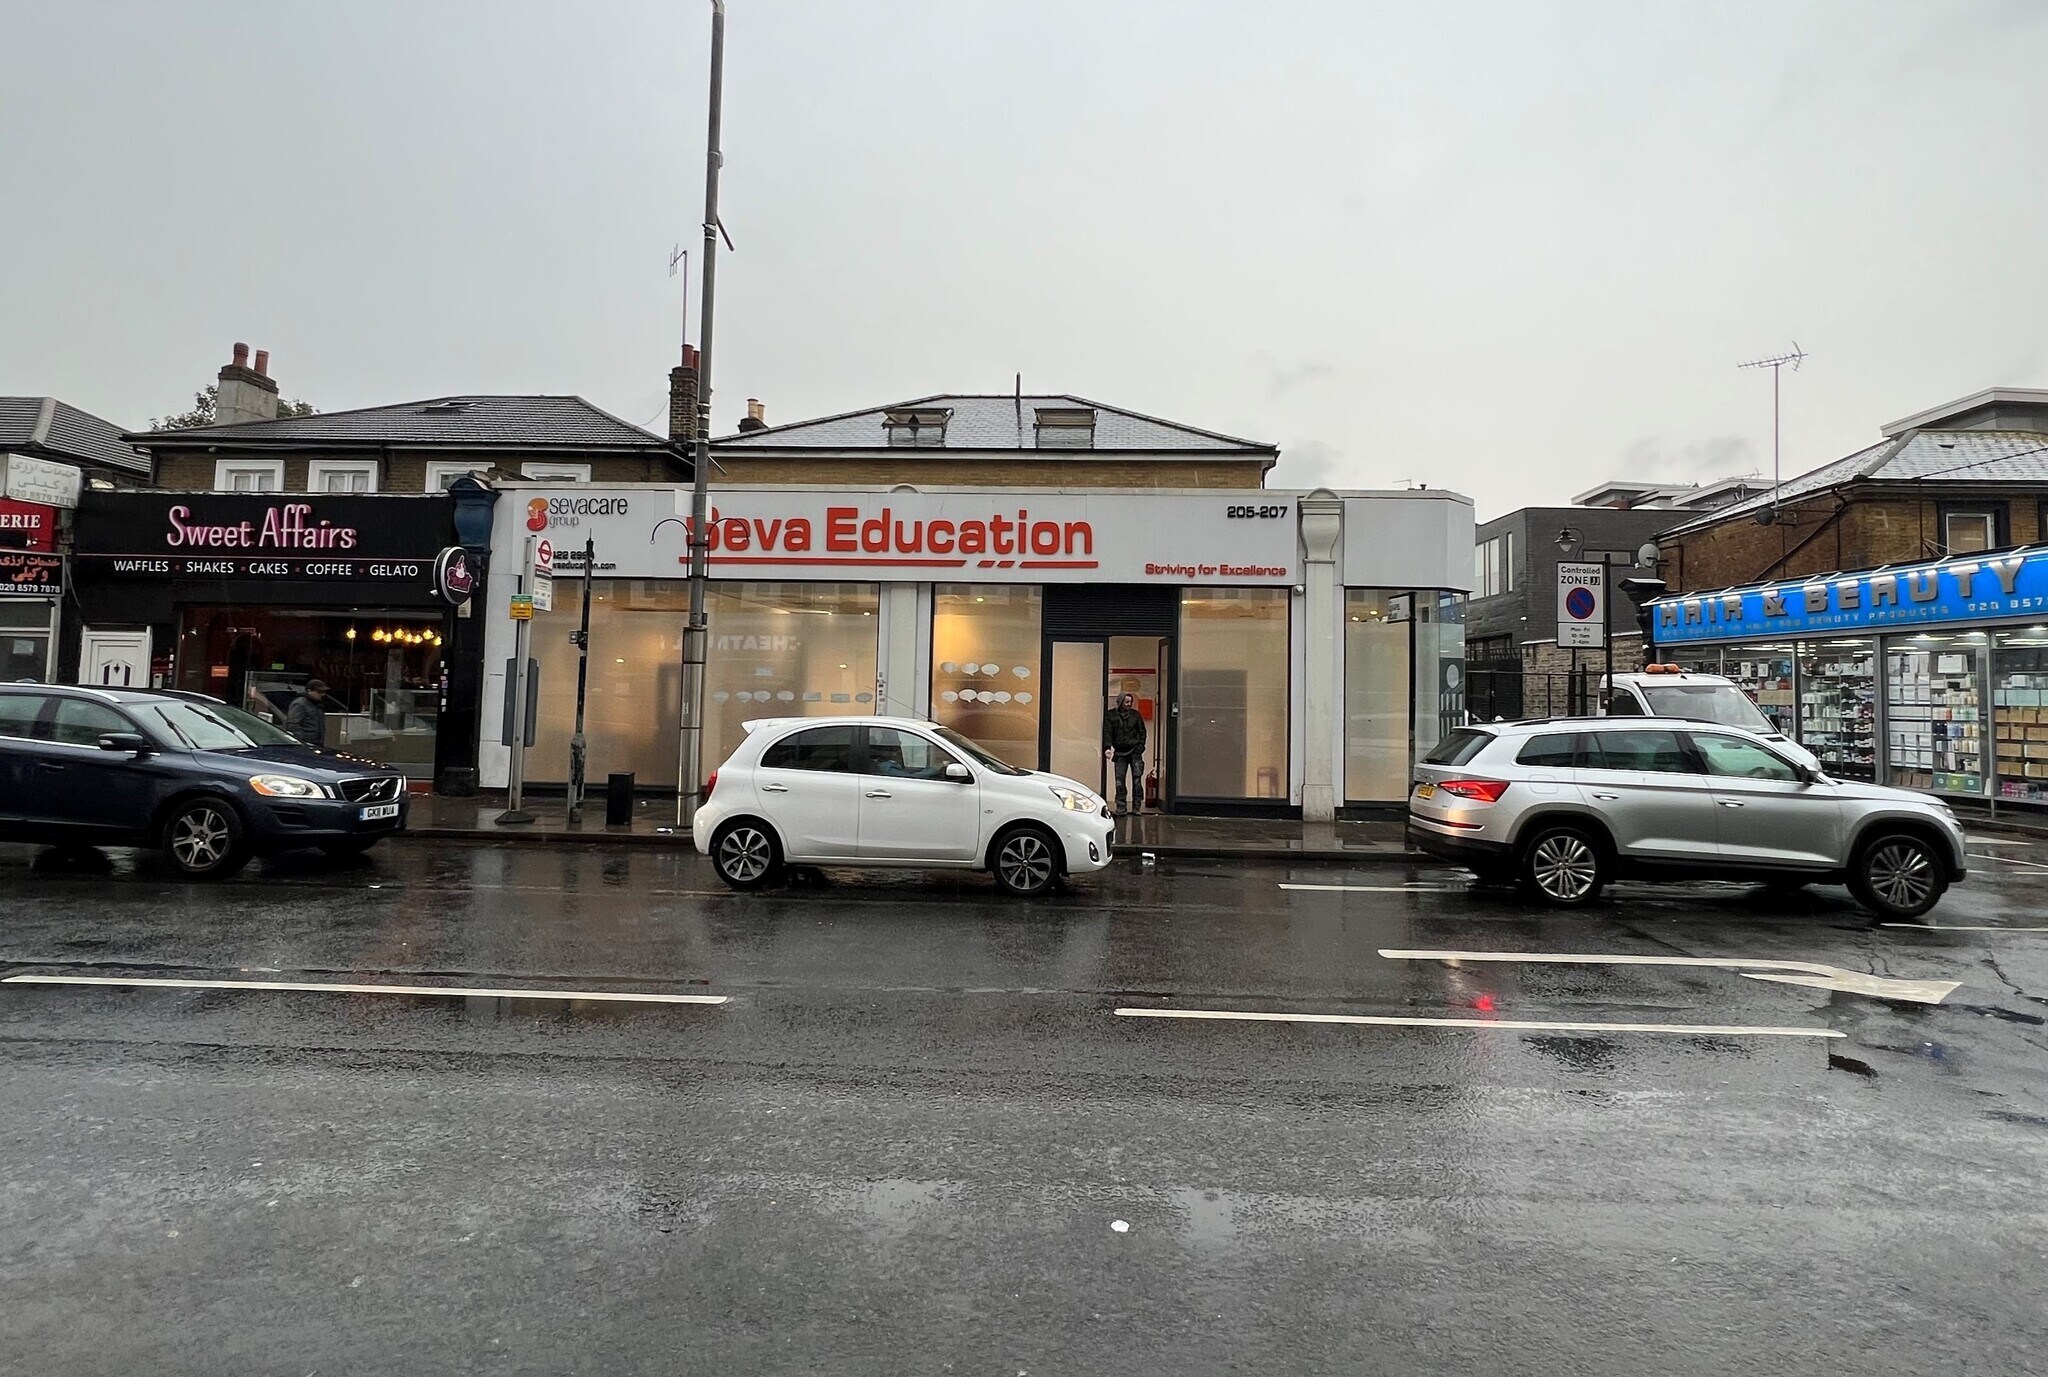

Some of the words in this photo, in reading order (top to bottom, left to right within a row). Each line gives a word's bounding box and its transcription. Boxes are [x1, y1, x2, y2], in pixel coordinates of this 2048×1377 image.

[9, 487, 27, 497] 020
[549, 497, 628, 516] sevacare
[1226, 506, 1288, 519] 205-207
[166, 505, 254, 547] Sweet
[258, 503, 357, 549] Affairs
[549, 515, 579, 529] group
[826, 507, 1093, 556] Education
[113, 559, 169, 573] WAFFLES
[186, 561, 235, 575] SHAKES
[249, 562, 289, 575] CAKES
[305, 563, 353, 576] COFFEE
[369, 564, 419, 577] GELATO
[1144, 563, 1196, 578] Striving
[1198, 563, 1218, 576] for
[1219, 564, 1287, 577] Excellence
[1560, 566, 1600, 575] Controlled
[1560, 575, 1589, 585] ZONE
[0, 583, 15, 592] 020
[17, 584, 39, 593] 8579
[1660, 594, 1743, 628] HAIR
[1761, 590, 1788, 618] &
[1803, 557, 2025, 614] BEAUTY
[1868, 605, 1949, 620] PRODUCTS
[1967, 600, 1999, 612] 020
[2009, 596, 2048, 609] 857
